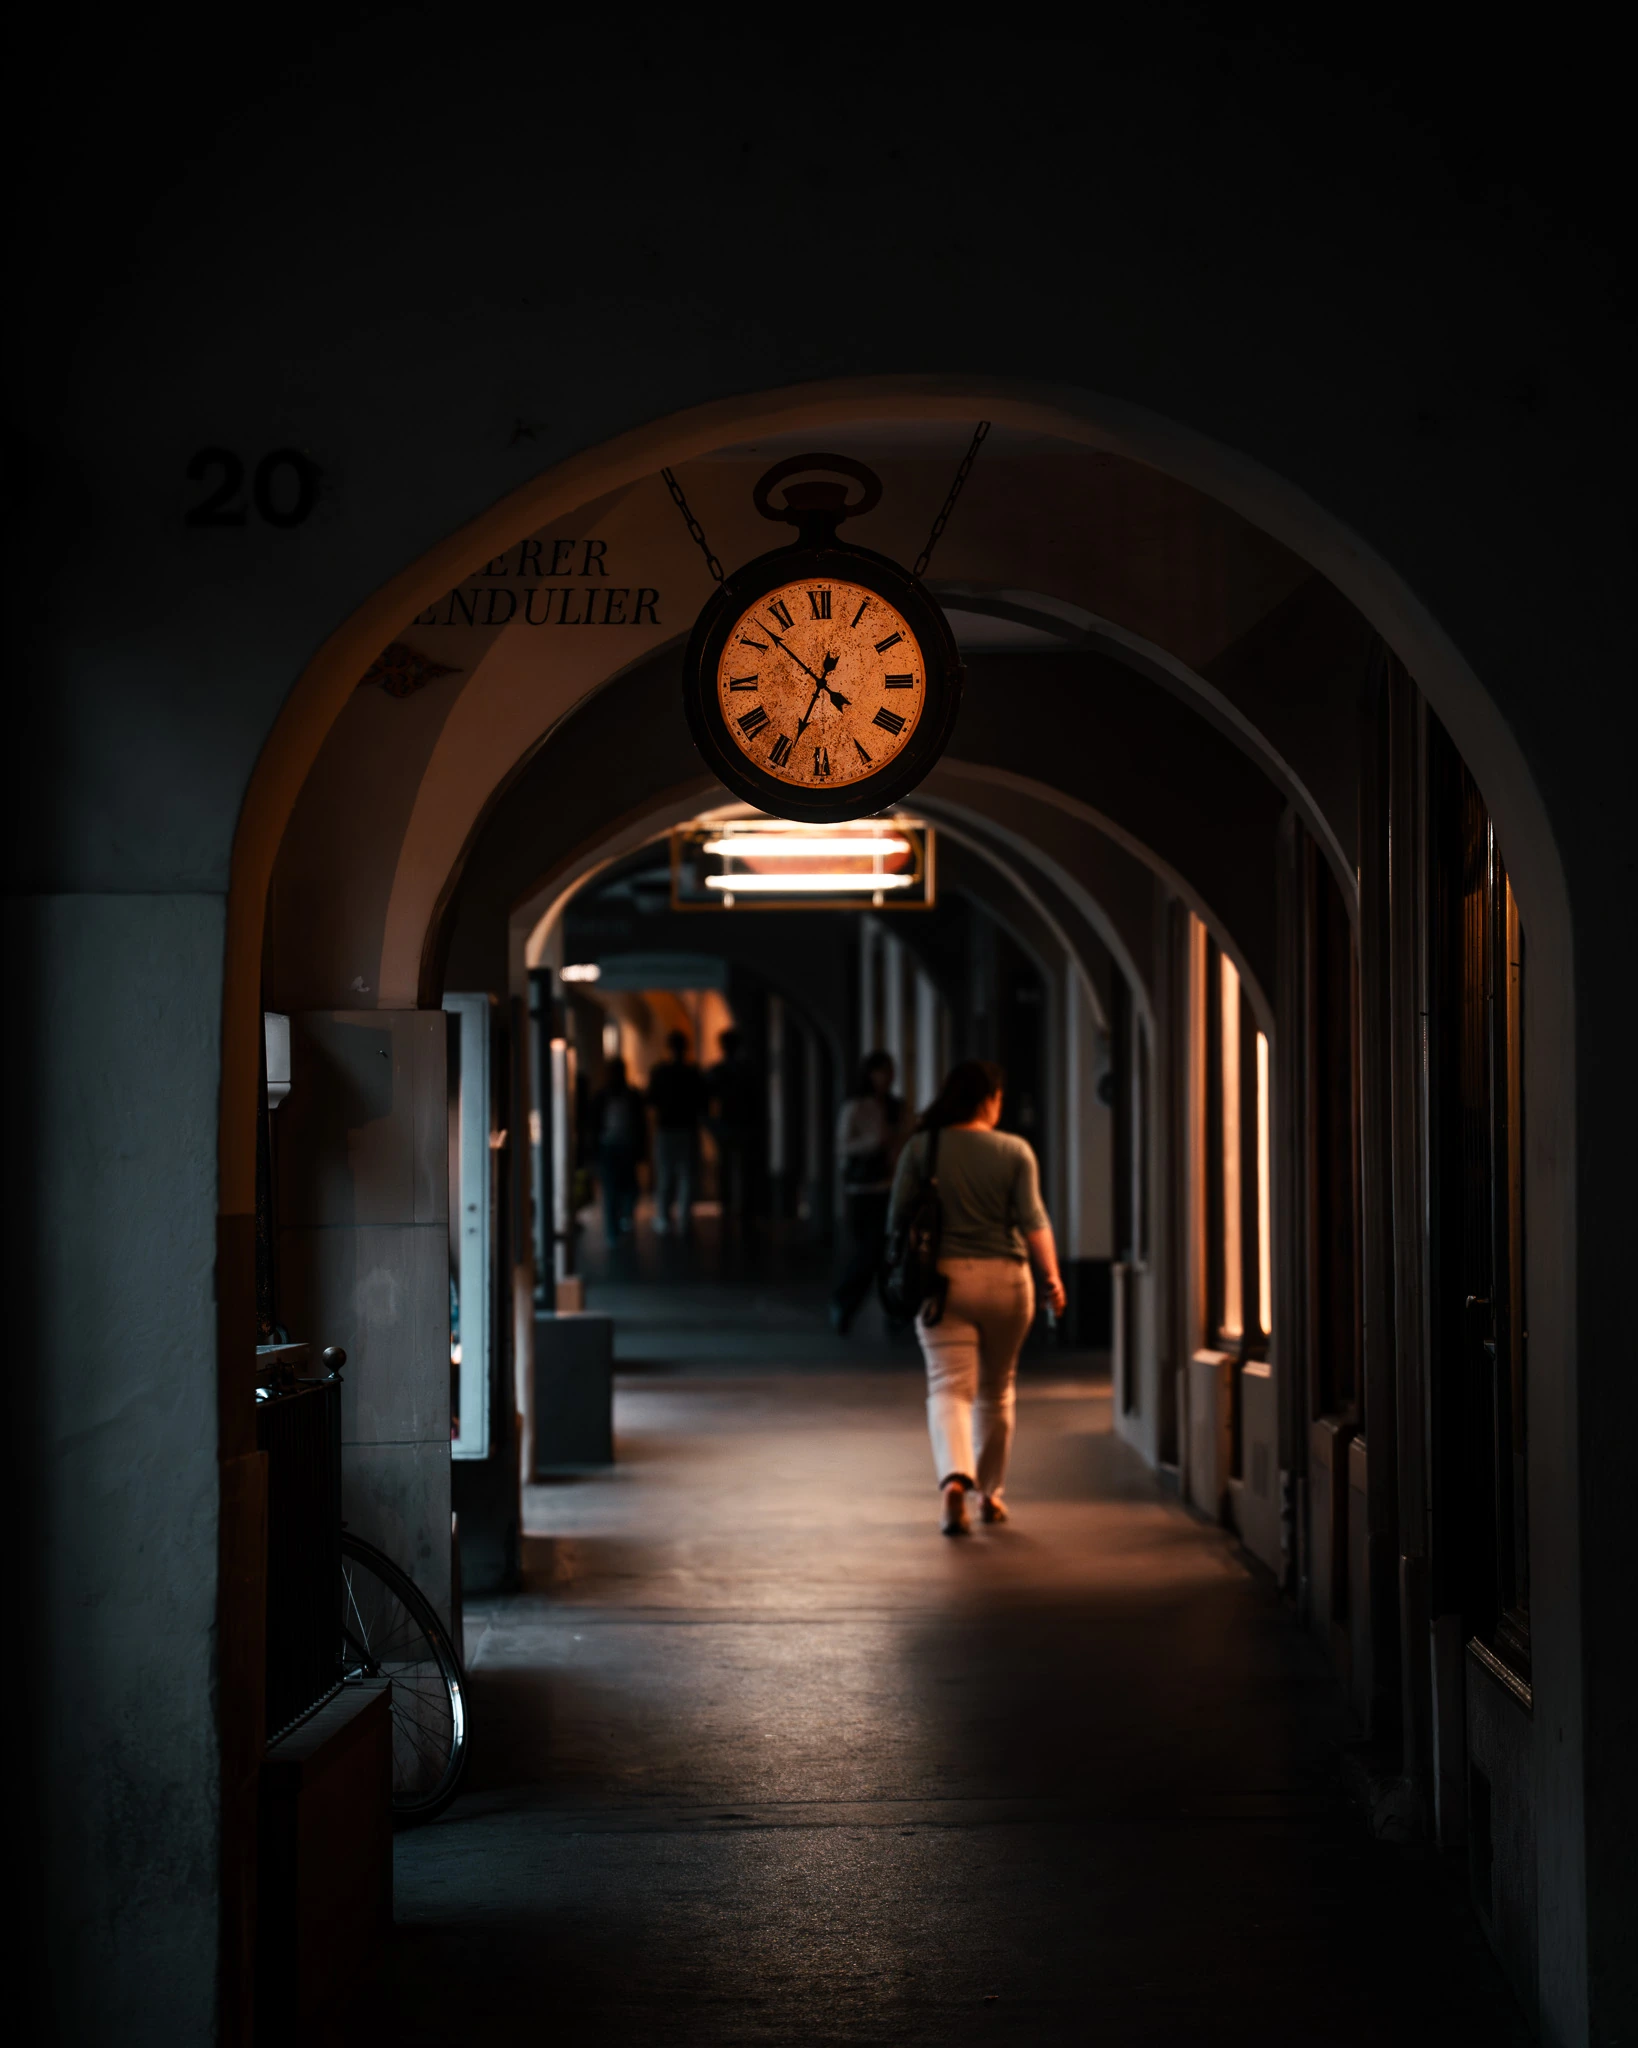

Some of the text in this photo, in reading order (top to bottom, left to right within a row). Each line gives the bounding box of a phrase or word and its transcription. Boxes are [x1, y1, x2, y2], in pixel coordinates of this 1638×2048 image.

[185, 448, 314, 528] 20
[470, 540, 610, 577] ERER
[807, 590, 832, 620] XII
